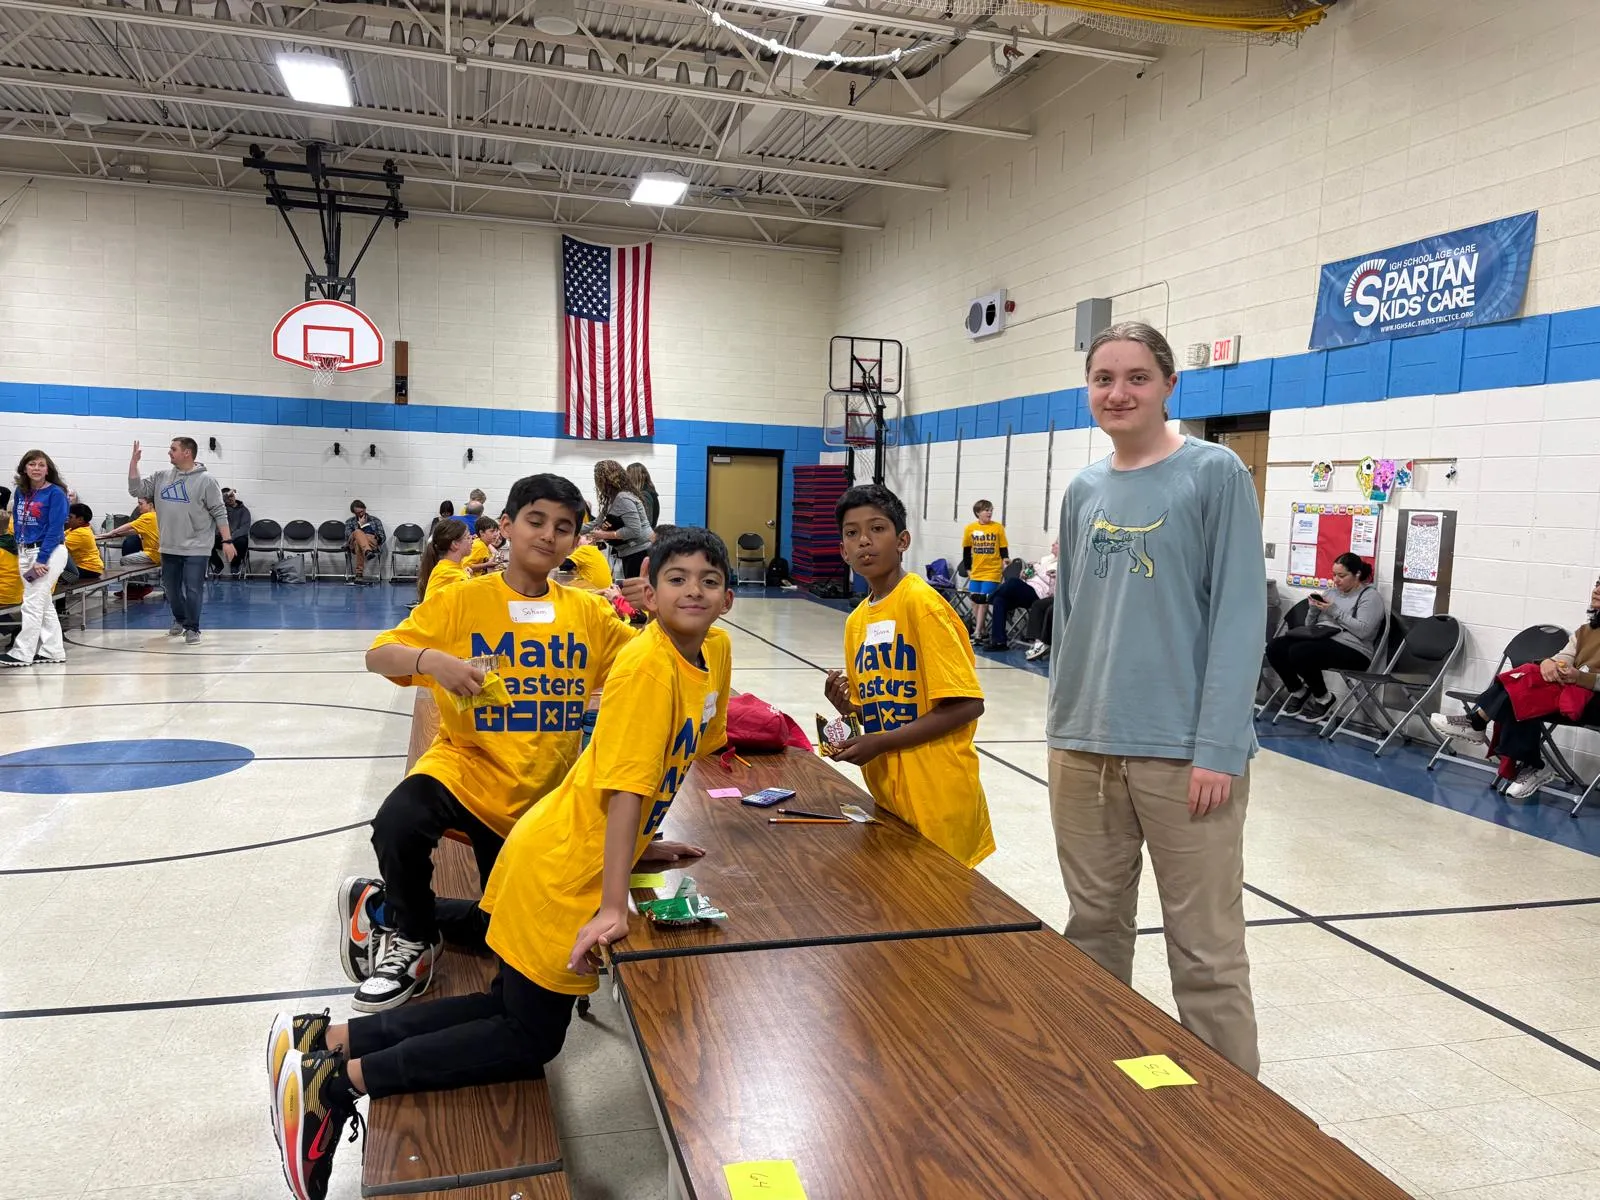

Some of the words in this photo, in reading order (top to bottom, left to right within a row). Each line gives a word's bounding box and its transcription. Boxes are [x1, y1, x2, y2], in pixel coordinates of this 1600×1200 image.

[1389, 262, 1402, 271] IGH
[1403, 254, 1434, 268] SCHOOL
[1435, 249, 1452, 260] AGE
[1453, 244, 1477, 256] CARE
[1353, 253, 1479, 327] SPARTAN
[1380, 294, 1426, 322] KIDS'
[1427, 285, 1475, 313] CARE
[1214, 339, 1231, 361] EXIT
[471, 632, 587, 669] Math
[496, 672, 585, 696] asters
[859, 676, 918, 699] asters
